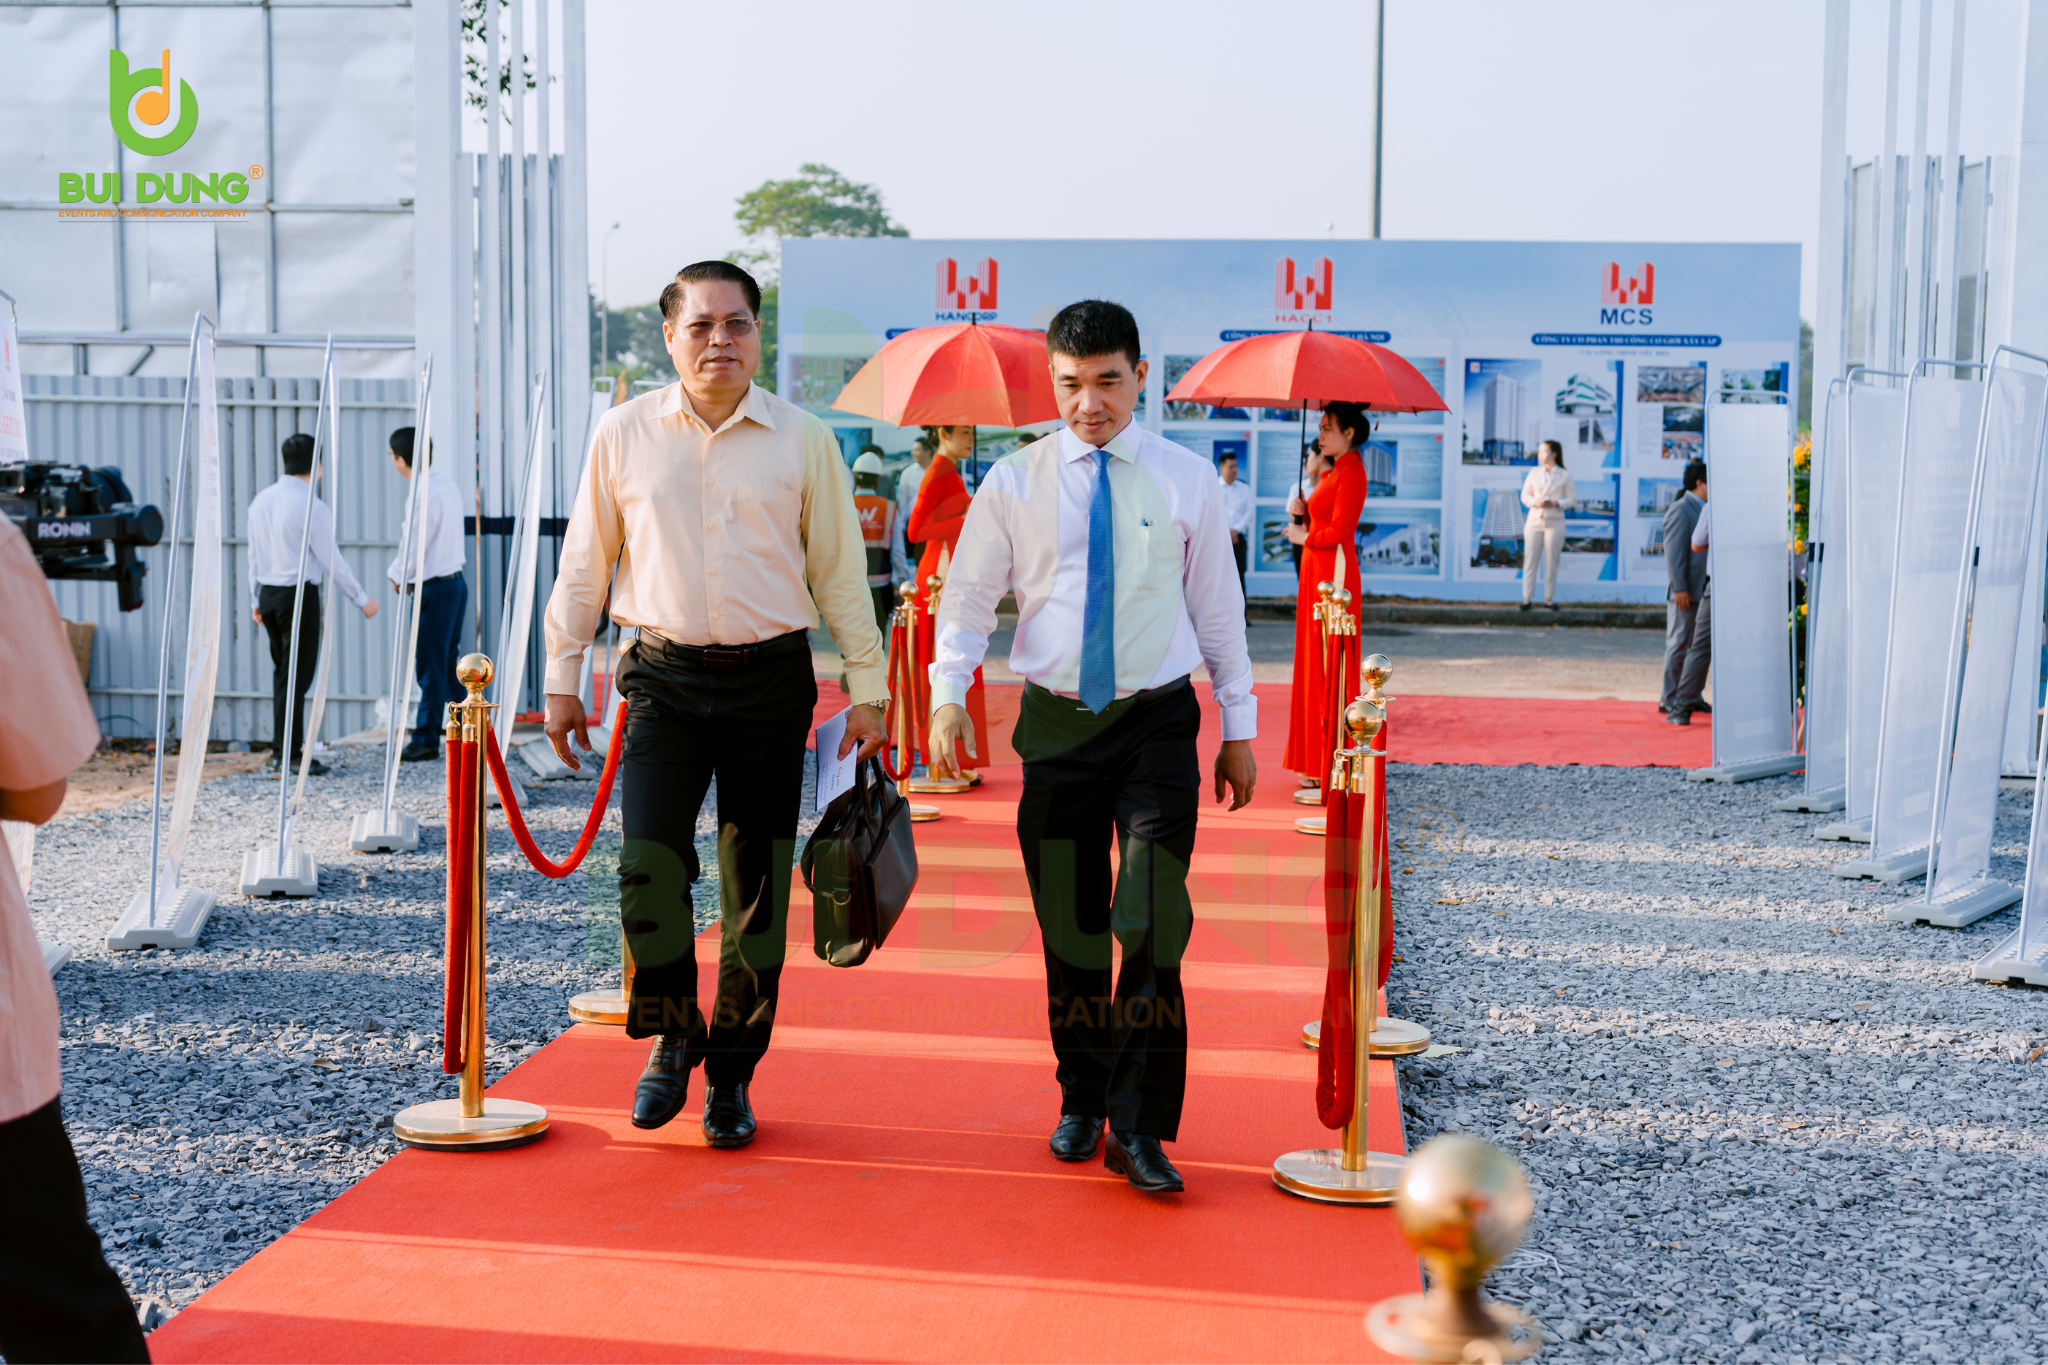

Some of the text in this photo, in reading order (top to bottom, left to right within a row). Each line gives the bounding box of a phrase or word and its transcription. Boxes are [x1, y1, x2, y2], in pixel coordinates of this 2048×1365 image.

[935, 312, 998, 321] HANCORP
[1600, 308, 1653, 325] MCS
[38, 521, 91, 538] RONIN
